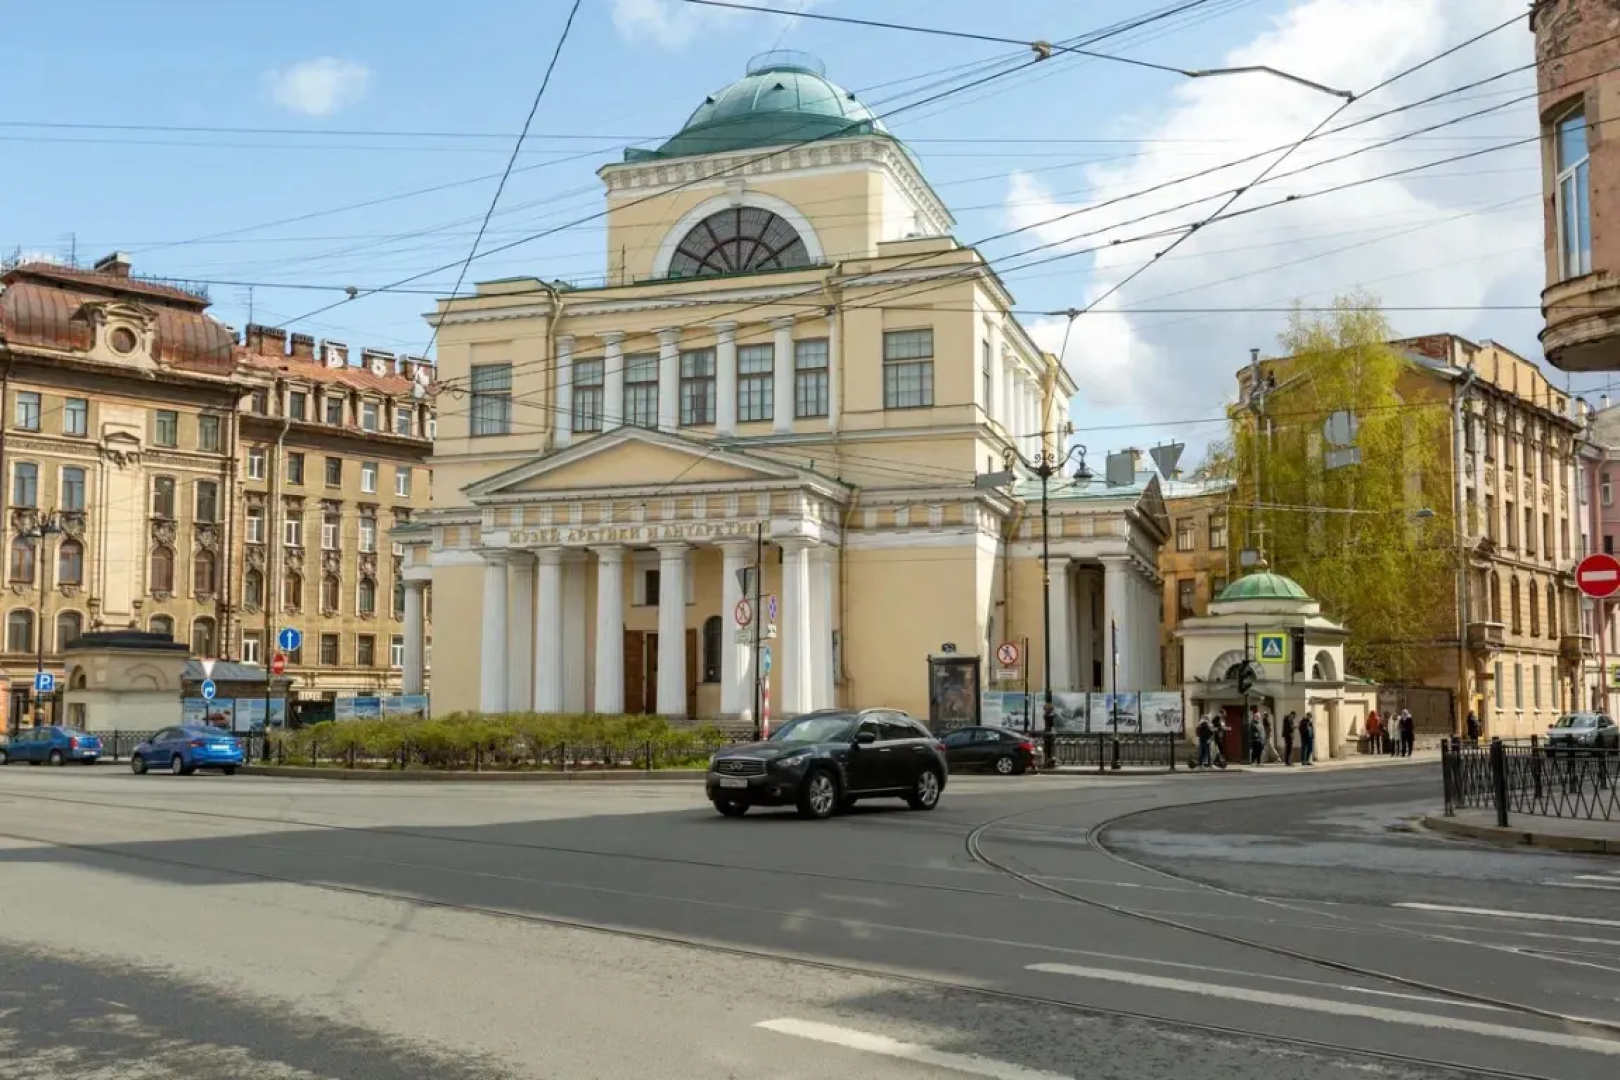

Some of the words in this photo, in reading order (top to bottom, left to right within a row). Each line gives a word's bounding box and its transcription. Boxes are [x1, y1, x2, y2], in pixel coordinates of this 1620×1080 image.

[509, 528, 560, 544] МУЗЕЙ
[567, 527, 640, 542] АРКТИКИ
[646, 526, 657, 540] И
[40, 674, 51, 689] P
